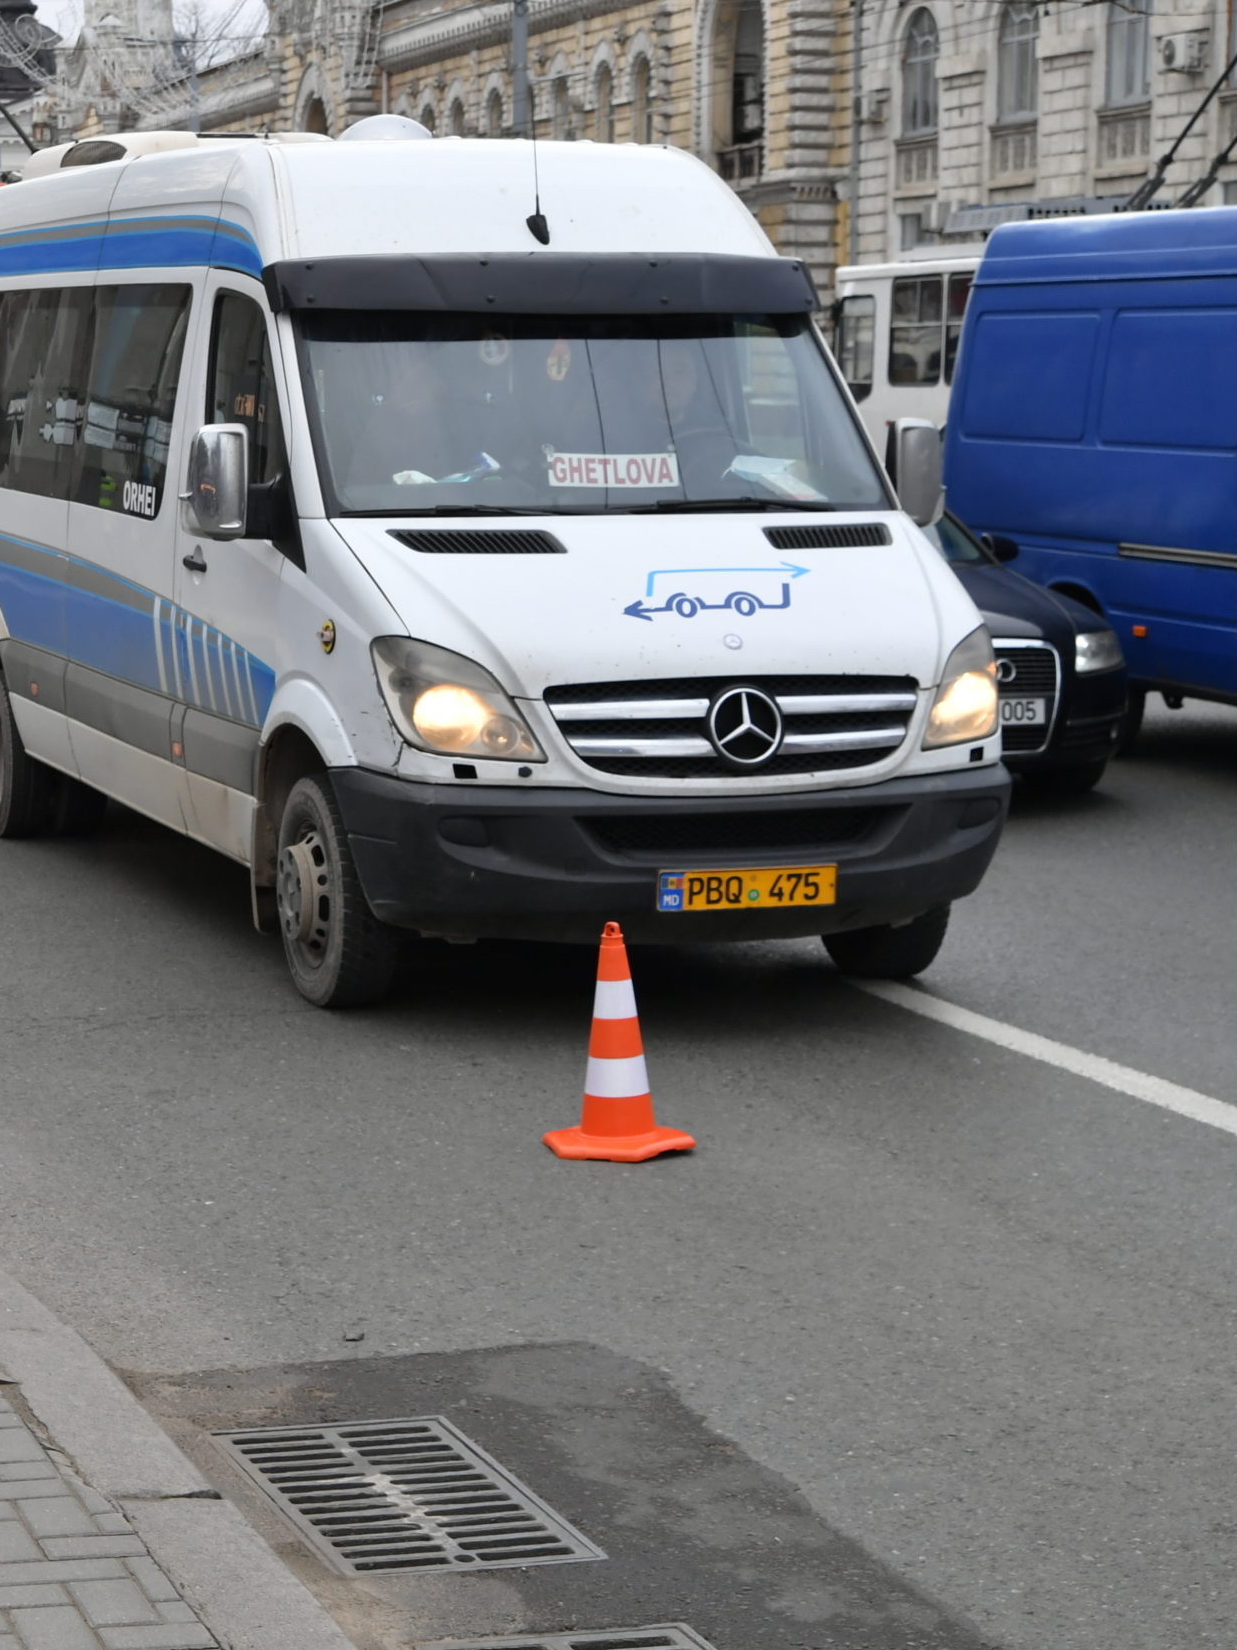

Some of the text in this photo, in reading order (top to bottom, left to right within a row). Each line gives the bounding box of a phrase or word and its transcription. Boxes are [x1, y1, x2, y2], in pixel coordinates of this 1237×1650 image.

[553, 456, 675, 485] GHETLOVA
[122, 480, 157, 517] ORHEI
[1001, 701, 1037, 722] 005
[662, 894, 681, 908] MD
[687, 872, 821, 906] PBQ 475
